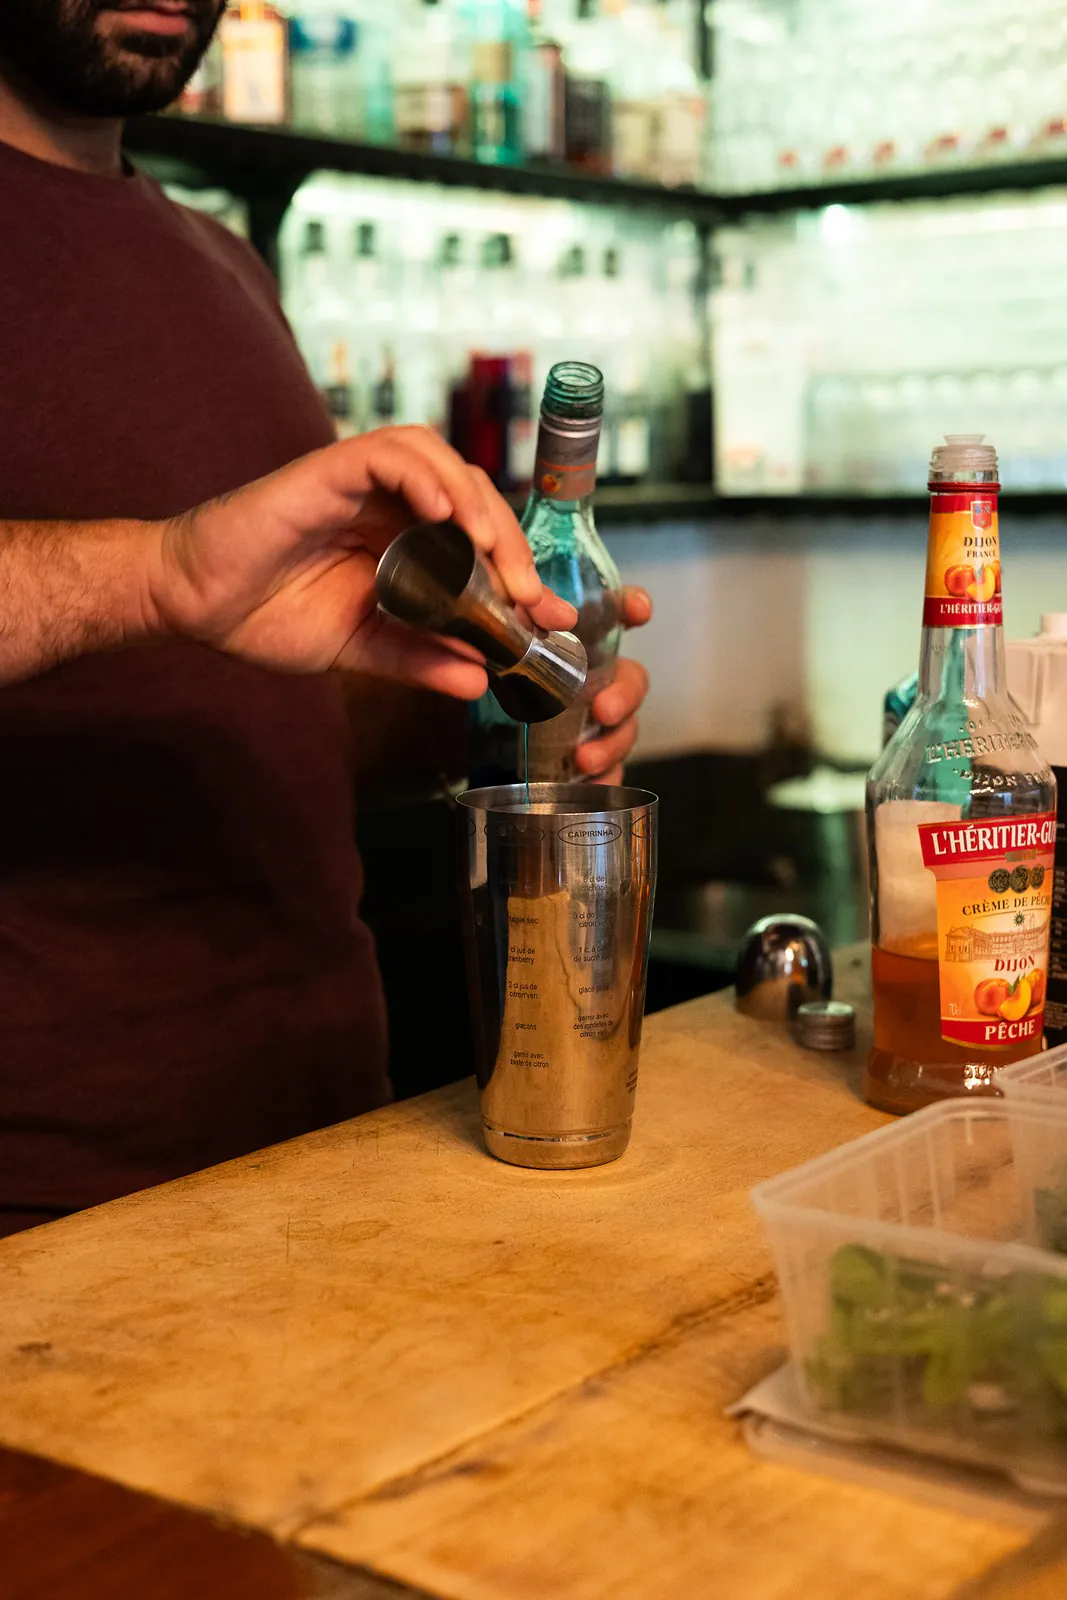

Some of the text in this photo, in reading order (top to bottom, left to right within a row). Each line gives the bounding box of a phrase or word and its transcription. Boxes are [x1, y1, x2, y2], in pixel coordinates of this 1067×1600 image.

[963, 535, 998, 548] DIJON
[966, 550, 997, 558] FRANCE
[962, 897, 1010, 917] CRÈME
[1014, 896, 1028, 908] DE
[527, 946, 536, 955] de
[994, 955, 1036, 972] DIJON
[529, 982, 538, 991] de
[984, 1019, 1035, 1041] PÊCHE
